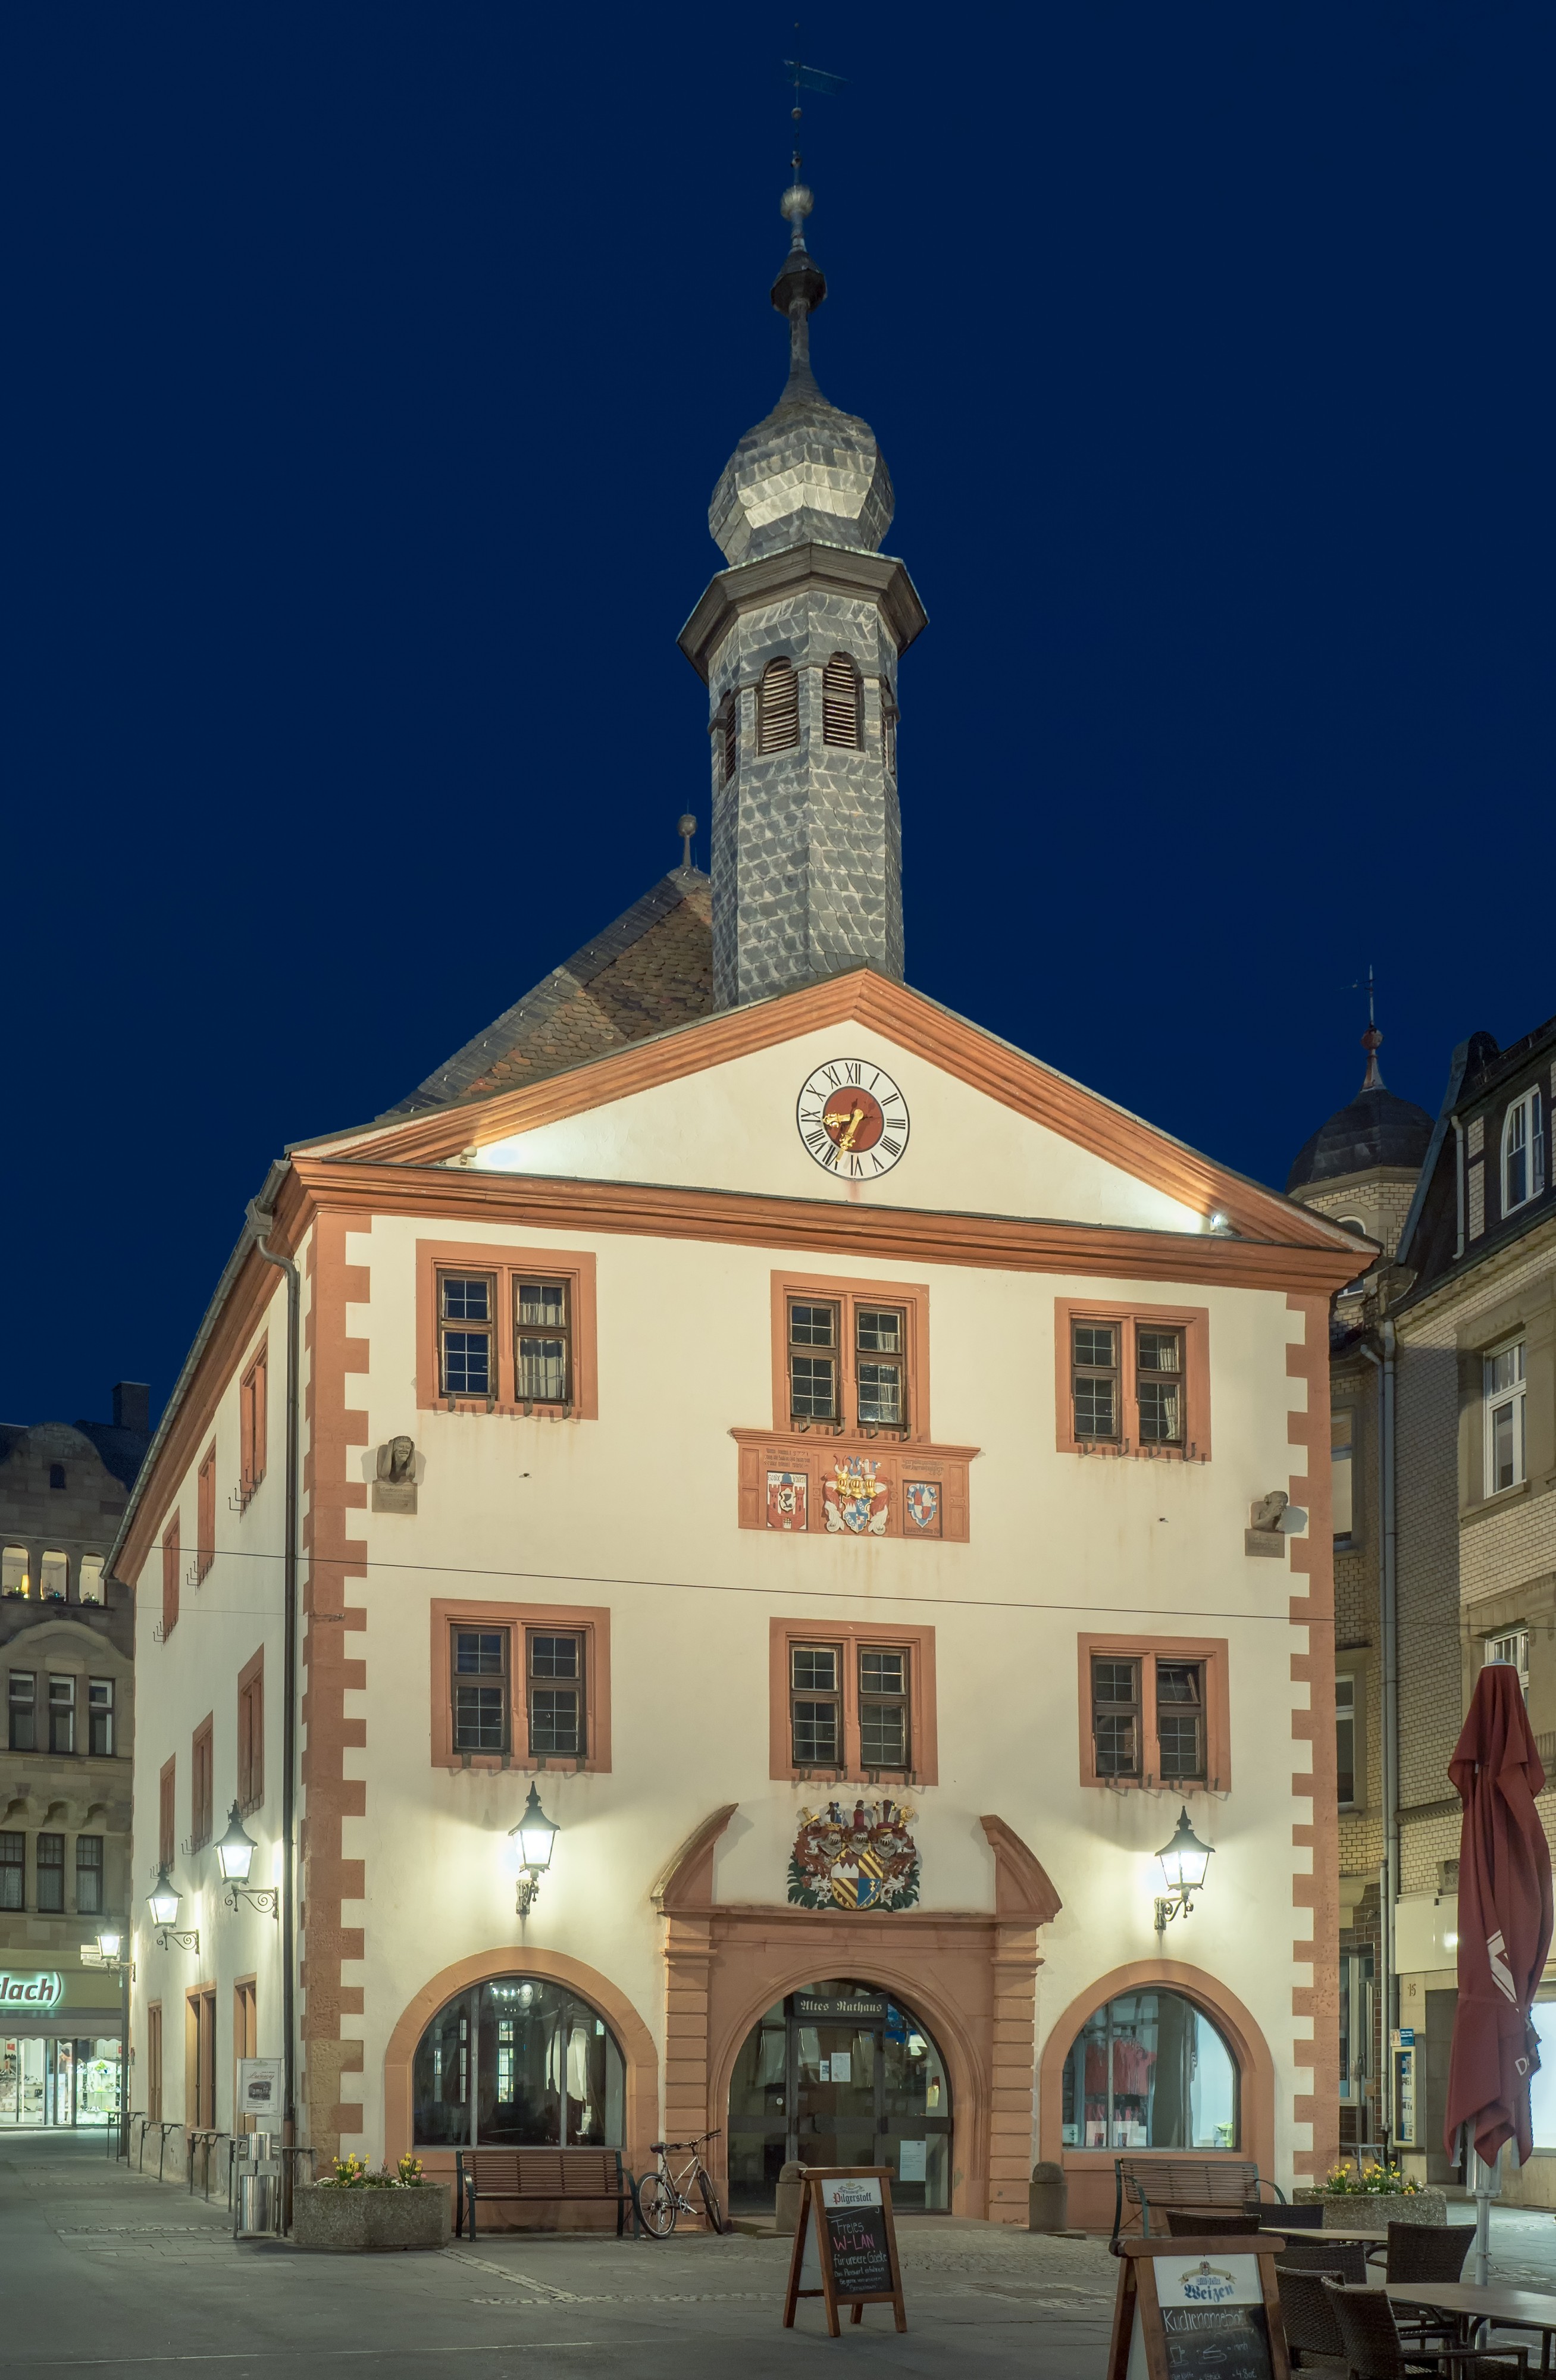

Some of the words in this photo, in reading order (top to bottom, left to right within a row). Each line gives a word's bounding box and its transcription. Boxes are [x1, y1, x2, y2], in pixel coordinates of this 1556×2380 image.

[822, 1065, 842, 1089] XI
[845, 1062, 861, 1085] XII
[869, 1072, 880, 1090] I
[806, 1083, 826, 1102] X
[881, 1092, 900, 1106] II
[800, 1107, 821, 1122] IX
[886, 1118, 906, 1129] III
[805, 1128, 828, 1155] VIII
[879, 1135, 902, 1157] IIII
[850, 1154, 863, 1176] VI
[871, 1152, 884, 1172] V
[0, 1971, 61, 2007] lach)
[1407, 1983, 1416, 1997] 15
[800, 2000, 829, 2011] Altes
[837, 2000, 882, 2013] Rathaus
[833, 2192, 872, 2204] Pilgerstoff
[831, 2218, 864, 2235] Freies
[833, 2234, 875, 2250] W-LAN
[1184, 2284, 1235, 2303] Weizen
